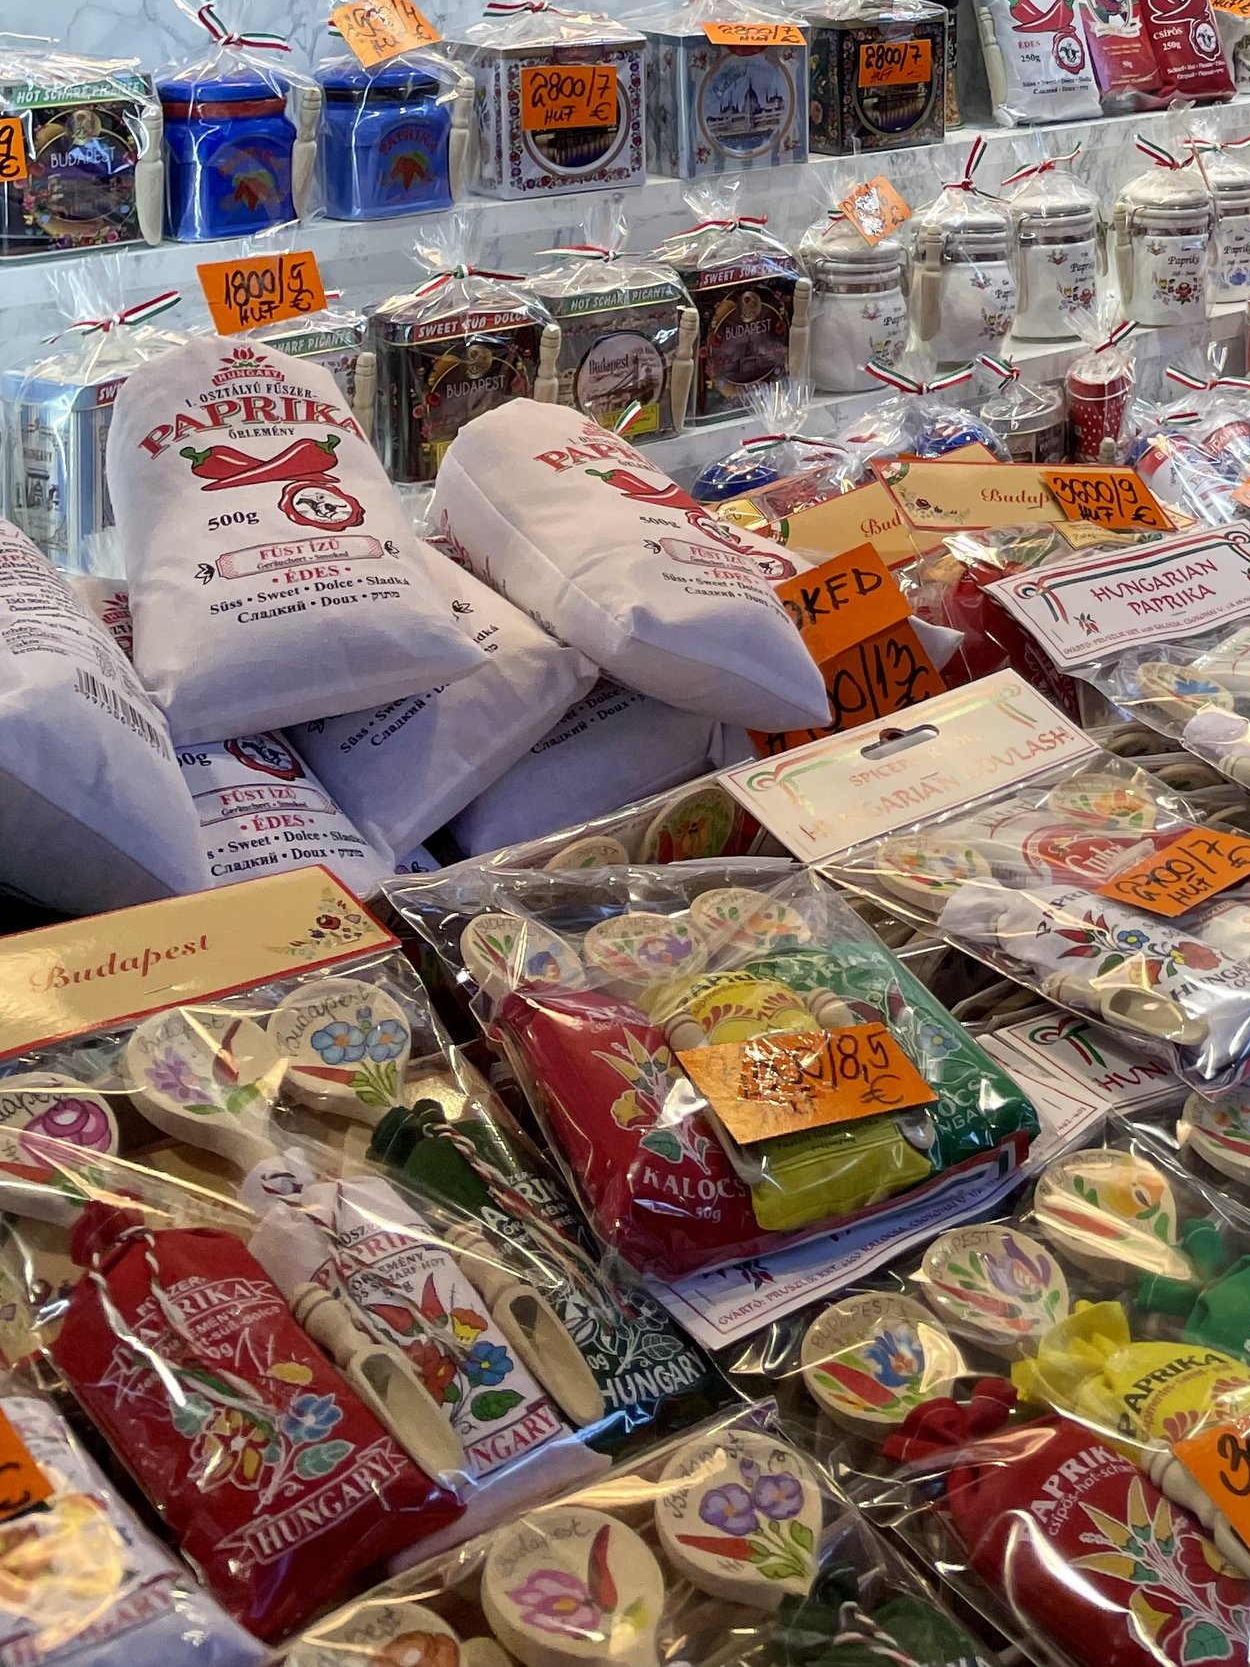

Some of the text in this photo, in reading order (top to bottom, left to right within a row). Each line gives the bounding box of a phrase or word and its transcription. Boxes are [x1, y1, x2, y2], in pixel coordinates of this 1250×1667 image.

[1018, 40, 1041, 49] ÉDES
[1153, 27, 1183, 40] CSÍPŐS
[1162, 42, 1181, 51] 250g
[864, 44, 922, 77] 2800/7
[1021, 54, 1041, 63] 250g
[16, 88, 42, 105] HOT
[531, 71, 609, 114] 2800/7
[544, 102, 611, 126] HUF €
[50, 146, 116, 170] BUDAPEST
[703, 270, 735, 285] SWEET
[570, 296, 589, 311] HOT
[418, 320, 458, 339] SWEET
[725, 318, 772, 341] BUDAPEST
[588, 354, 630, 373] Budapest
[218, 369, 282, 383] HUNGARY
[445, 375, 505, 399] BUDAPEST
[199, 381, 262, 405] OSZTÁLYÚ
[138, 396, 367, 459] PAPRIKA
[228, 426, 295, 440] ŐRLEMÉNY
[1053, 474, 1137, 518] 3600/9
[207, 509, 260, 531] 500g
[639, 516, 681, 529] 500g
[1079, 504, 1115, 522] HUF
[259, 543, 302, 560] FÜST
[284, 563, 340, 585] ÉDES
[1090, 559, 1218, 602] HUNGARIAN
[210, 597, 244, 616] Süss
[257, 587, 300, 605] Sweet
[315, 578, 354, 593] Dolce
[321, 592, 358, 609] Doux
[1126, 584, 1216, 616] PAPRIKA
[237, 601, 307, 624] Сладкий
[370, 697, 427, 748] Сладкий
[340, 726, 370, 755] Süss
[221, 790, 265, 806] FÜST
[252, 813, 305, 830] ÉDES
[229, 830, 321, 855] Sweet Dolce
[291, 846, 328, 862] Doux
[210, 853, 279, 879] Сладкий
[1113, 837, 1223, 903] 2700/7
[29, 934, 210, 994] Budapest
[1116, 1348, 1225, 1438] PAPRIKA
[255, 1451, 392, 1557] HUNGARY
